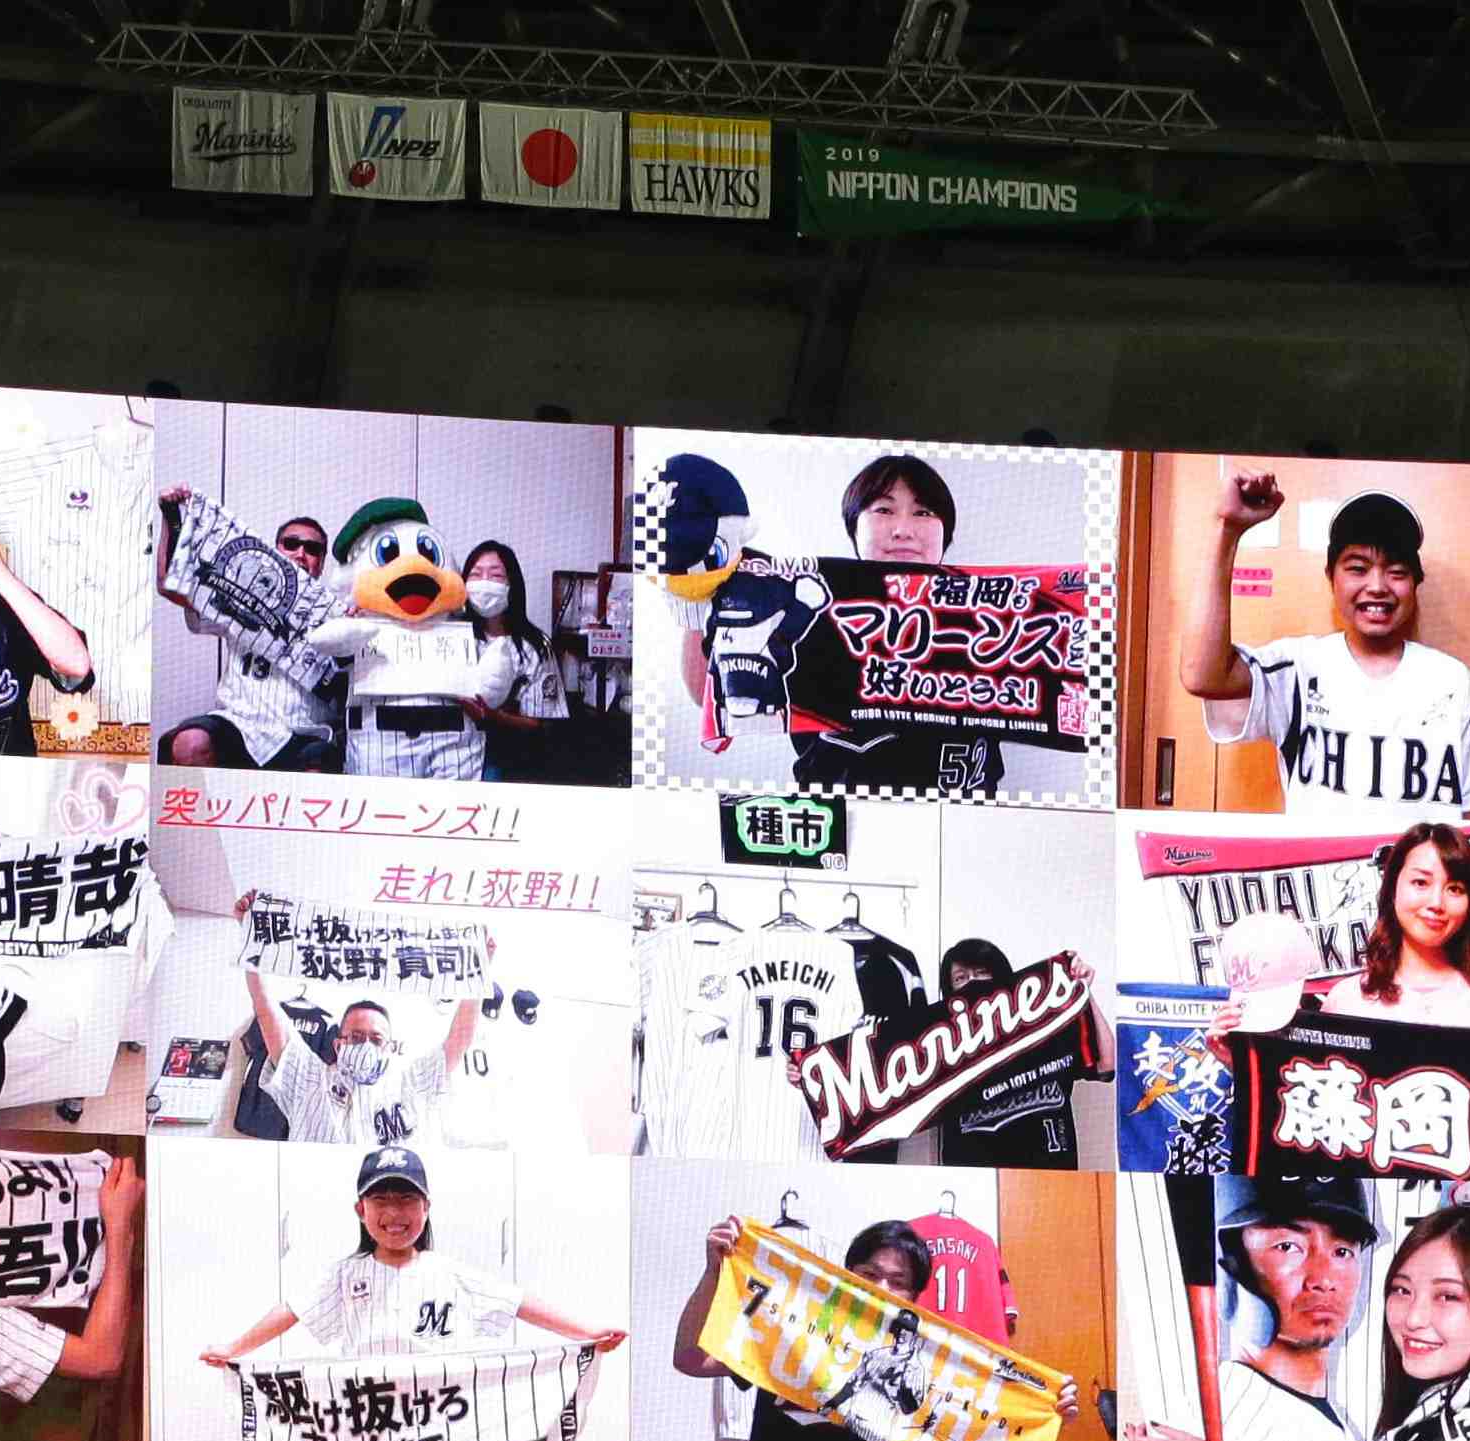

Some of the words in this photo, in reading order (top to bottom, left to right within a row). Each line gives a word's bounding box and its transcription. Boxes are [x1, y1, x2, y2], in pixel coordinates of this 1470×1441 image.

[195, 123, 295, 153] Marines
[384, 139, 441, 157] NPB
[826, 147, 880, 163] 2019
[643, 163, 760, 209] HAWKS
[827, 170, 919, 201] NIPPON
[929, 176, 1077, 212] CHAMPIONS
[835, 604, 1072, 669] マリーンズ
[938, 739, 986, 793] 52
[1297, 724, 1464, 805] CHIBA
[743, 804, 827, 850] 種市
[736, 959, 837, 995] TANEICHI
[754, 994, 820, 1059] 16
[1135, 1001, 1169, 1014] CHIBA
[1172, 1003, 1208, 1015] LOTTE
[801, 965, 1083, 1143] Marines
[925, 1237, 979, 1265] SASAKI
[745, 1278, 769, 1319] 7
[934, 1264, 968, 1313] 11
[253, 1370, 470, 1436] 駆け抜けろ
